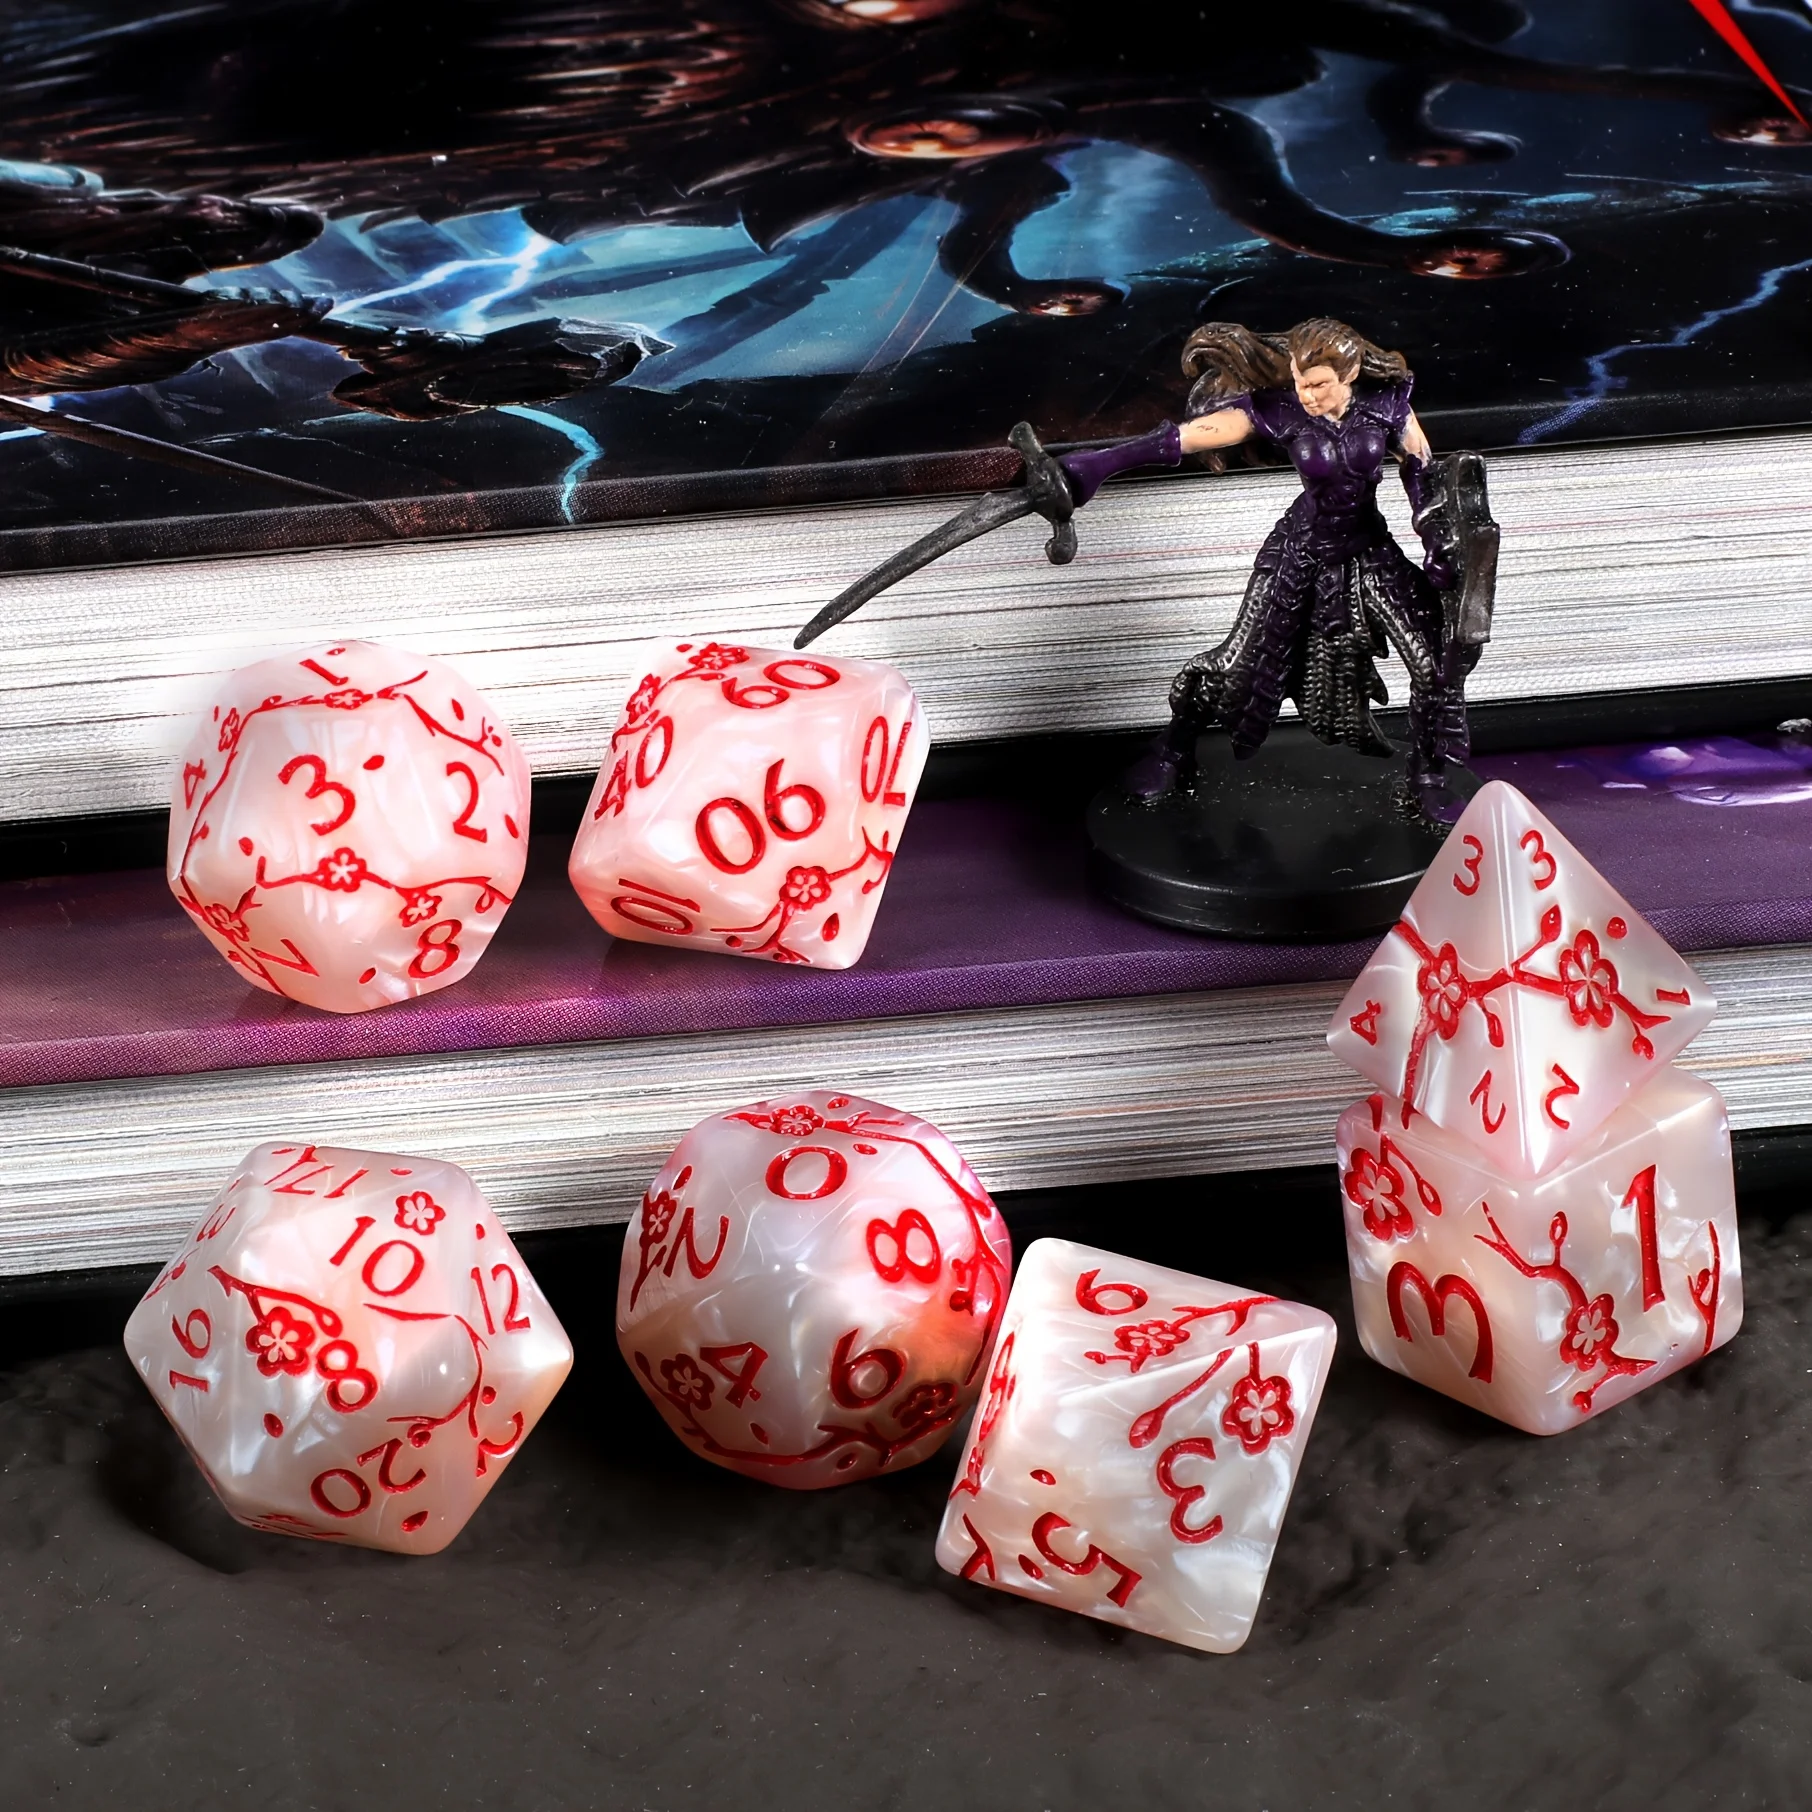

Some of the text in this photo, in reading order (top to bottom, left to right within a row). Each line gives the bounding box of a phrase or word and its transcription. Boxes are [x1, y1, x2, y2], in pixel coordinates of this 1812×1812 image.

[722, 659, 841, 710] 60
[183, 758, 207, 810] 4
[278, 754, 356, 837] 3
[446, 761, 488, 844] 2
[594, 716, 674, 821] 40
[1453, 834, 1484, 897] 3
[1520, 829, 1557, 891] 3
[408, 918, 463, 979] 8
[1349, 999, 1382, 1046] 4
[1656, 987, 1691, 1006] 1
[1470, 1069, 1506, 1134] 2
[1545, 1063, 1580, 1130] 2
[765, 1146, 848, 1201] 0
[329, 1215, 425, 1297] 10
[662, 1206, 730, 1280] 2
[865, 1208, 944, 1284] 8
[1624, 1164, 1666, 1312] 1
[470, 1263, 531, 1335] 12
[1075, 1269, 1149, 1316] 6
[1387, 1260, 1494, 1385] 3
[169, 1308, 212, 1393] 16
[316, 1339, 378, 1413] 8
[699, 1340, 769, 1409] 4
[830, 1328, 908, 1410] 6
[310, 1437, 427, 1519] 20
[475, 1410, 525, 1478] 2
[1156, 1437, 1223, 1544] 3
[1031, 1511, 1142, 1608] 5
